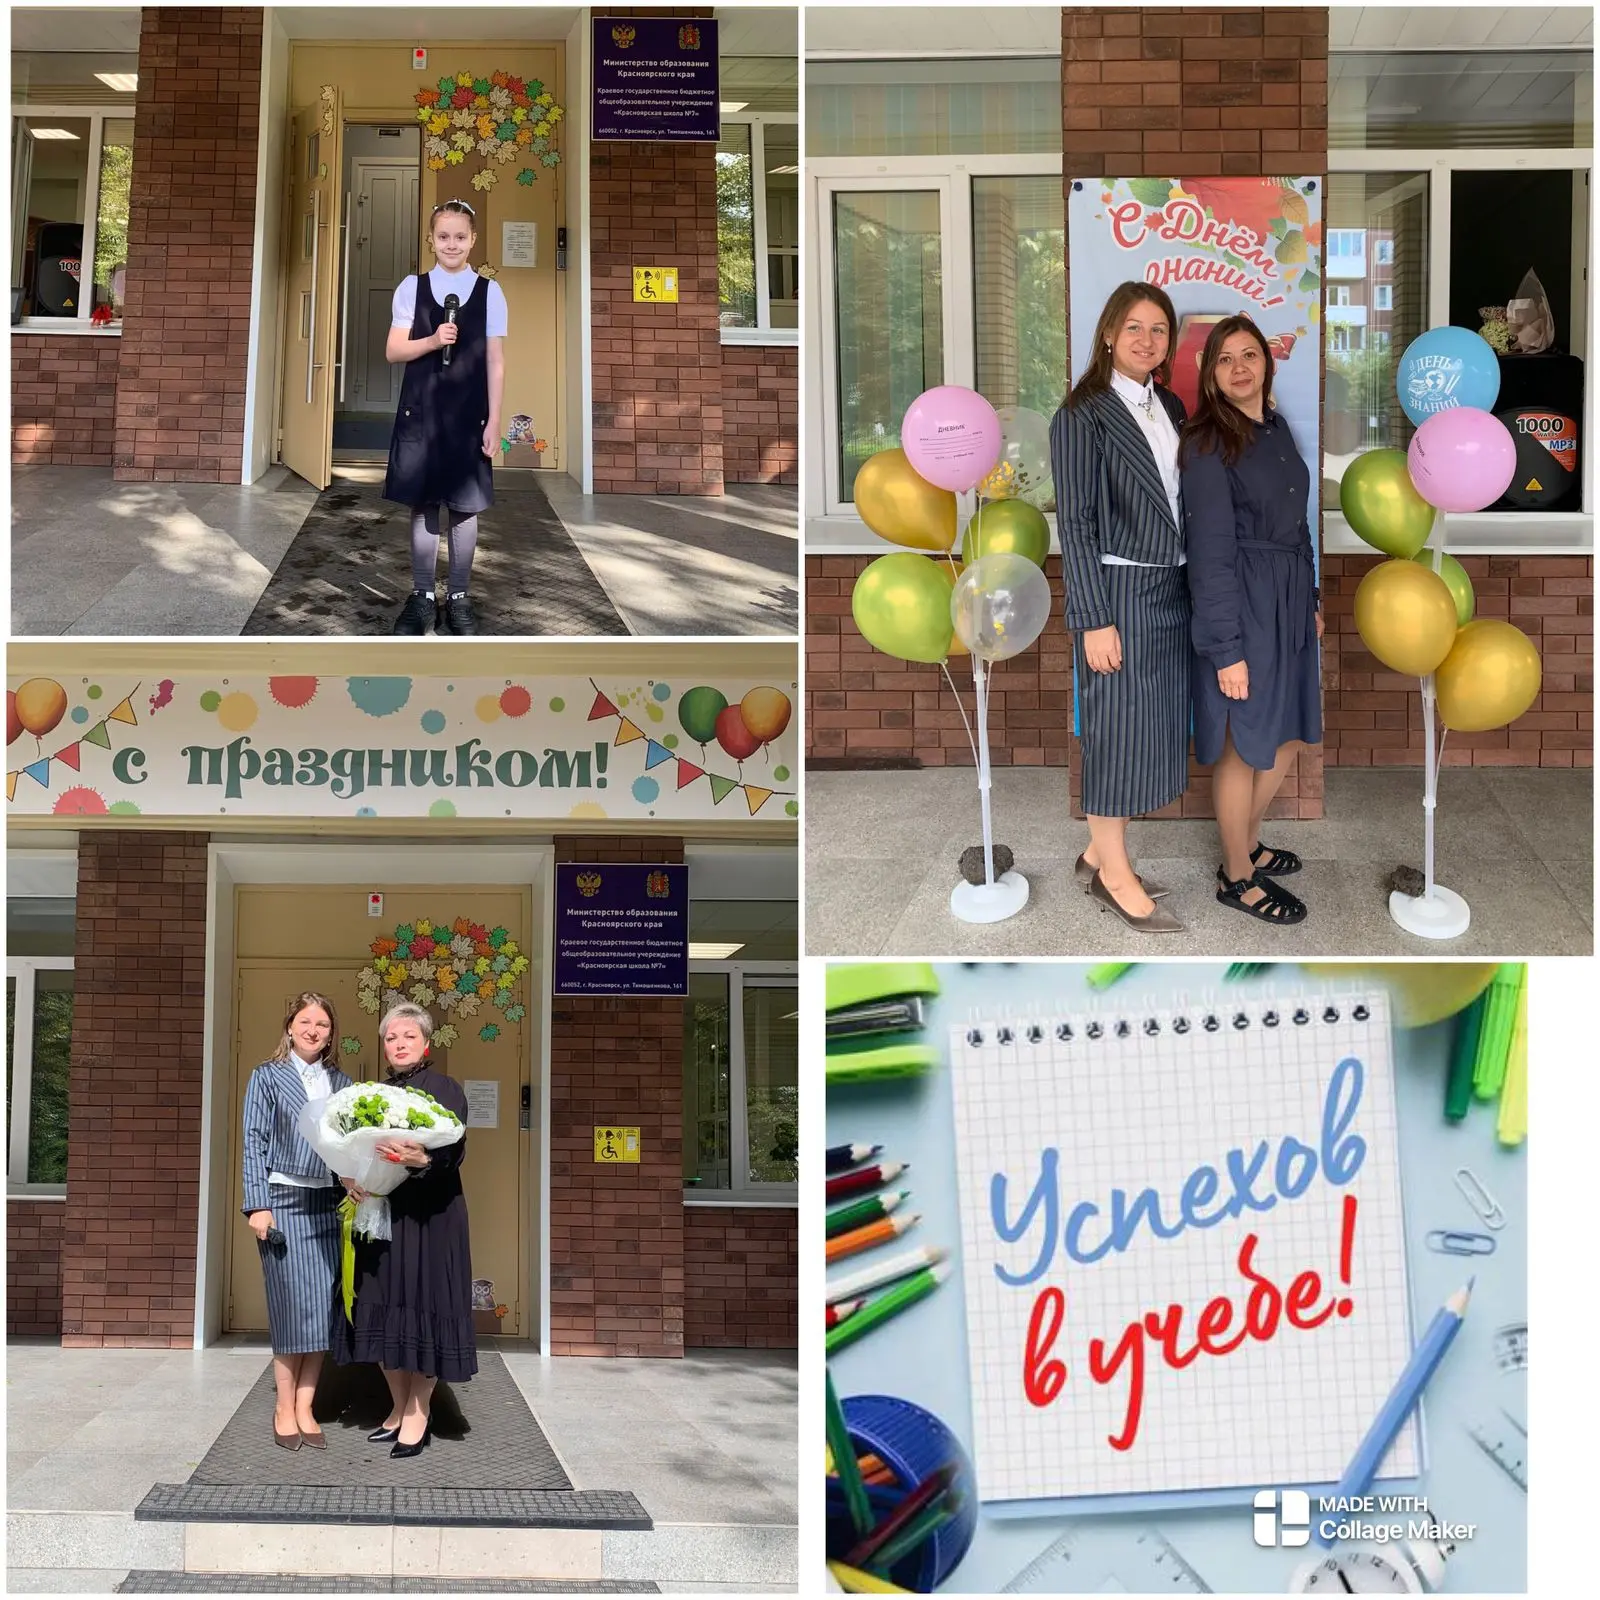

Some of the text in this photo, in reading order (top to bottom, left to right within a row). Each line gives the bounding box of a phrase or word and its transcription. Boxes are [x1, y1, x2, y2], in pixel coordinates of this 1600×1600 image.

[603, 59, 709, 68] Министерство образования
[617, 70, 676, 78] Красноярского
[597, 87, 715, 96] Краевое государственное бюджетное
[598, 98, 671, 106] общеобразовательное
[1107, 201, 1278, 278] С Днём
[1415, 355, 1453, 373] ДЕНЬ
[1409, 395, 1461, 413] ЗНАНИЙ
[1516, 417, 1565, 434] 1000
[1549, 440, 1573, 449] MP3
[112, 736, 610, 799] с праздником!
[566, 908, 678, 917] Министерство образования
[581, 920, 663, 930] Красноярского края
[645, 939, 684, 947] бюджетное
[561, 950, 636, 958] общеобразовательное
[990, 1057, 1367, 1287] Успехов
[1023, 1194, 1358, 1452] в учебе!
